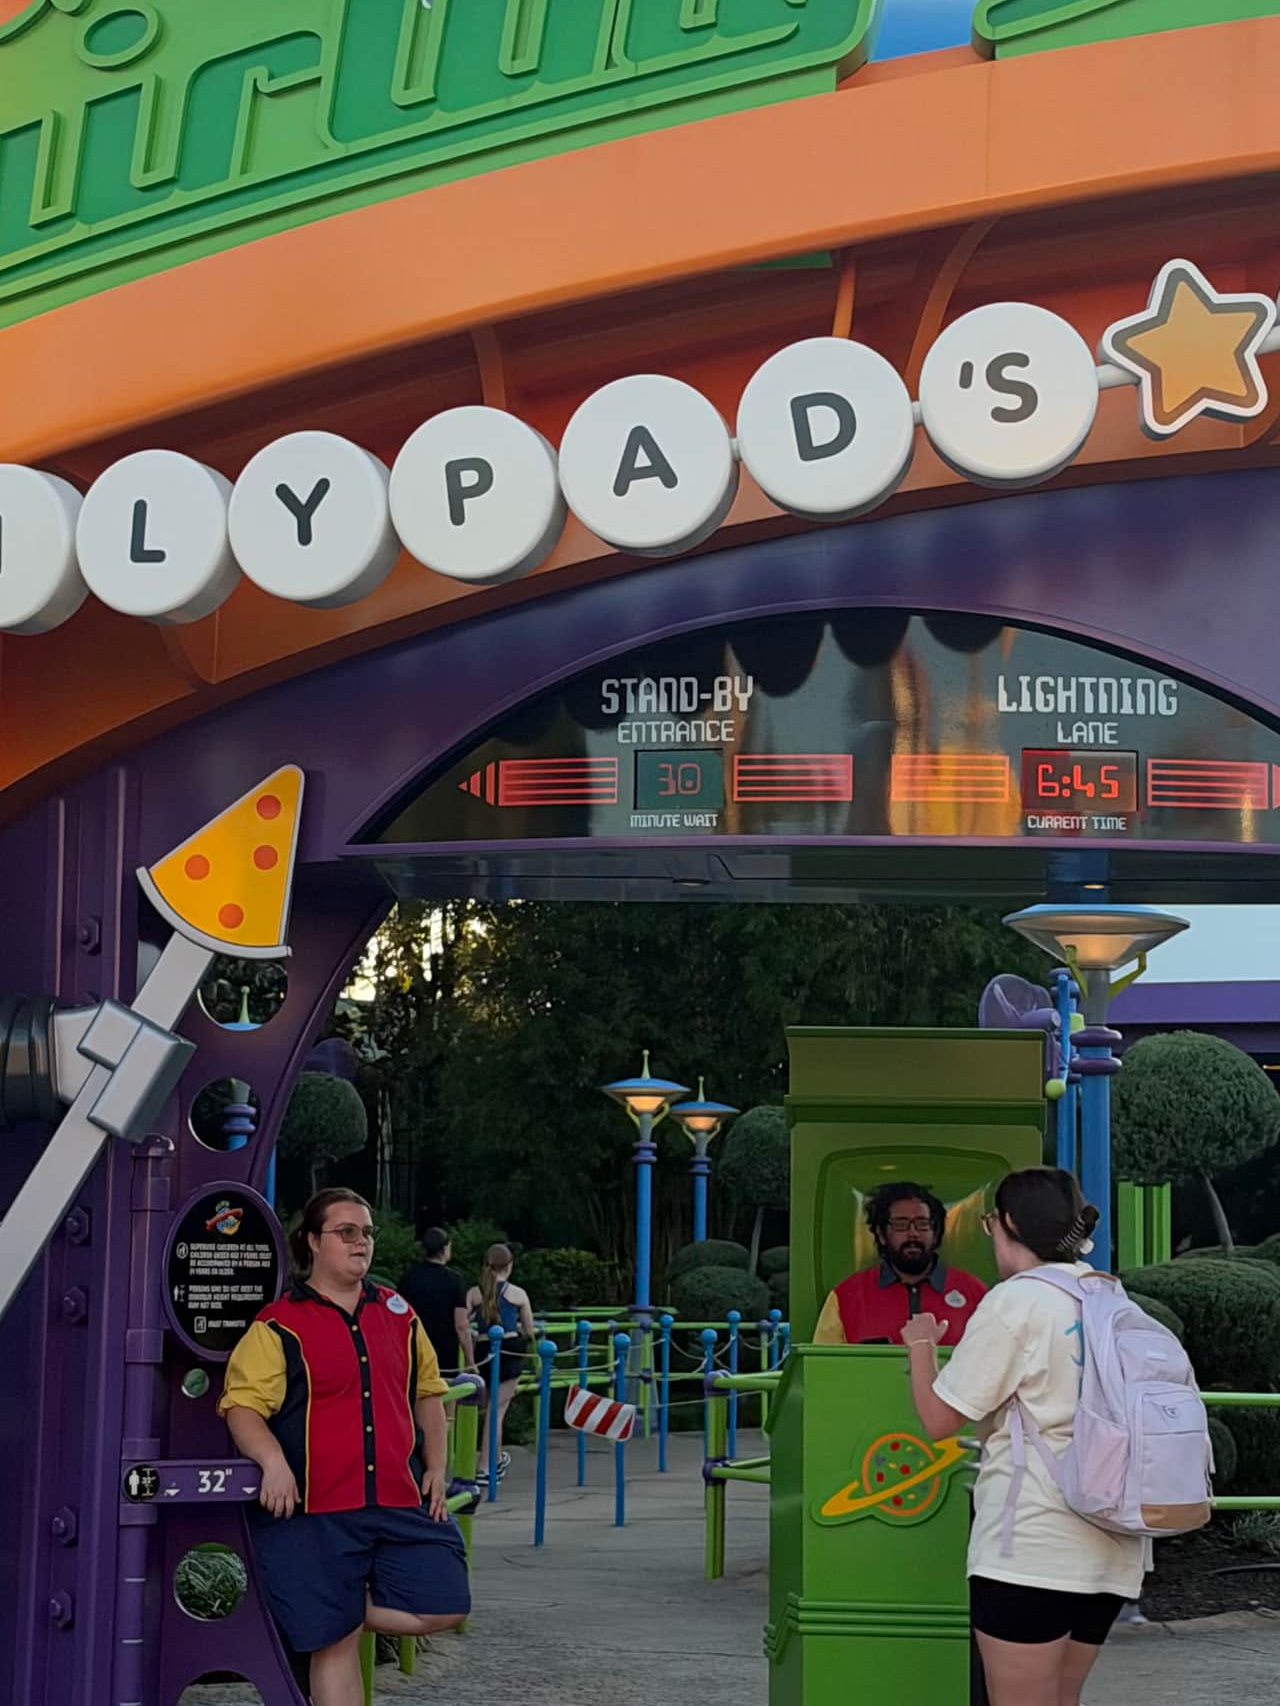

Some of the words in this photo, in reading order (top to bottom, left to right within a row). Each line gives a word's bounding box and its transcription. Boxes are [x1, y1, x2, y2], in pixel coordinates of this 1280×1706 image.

[601, 676, 753, 714] STAND-BY
[998, 675, 1178, 715] LIGHTNING
[617, 720, 735, 743] ENTRANCE
[1057, 721, 1118, 744] LANE
[657, 763, 702, 796] 30
[1037, 764, 1119, 797] 6:45
[630, 814, 680, 827] MINUTE
[683, 814, 718, 827] WAIT
[1027, 816, 1087, 830] CURRENT
[1091, 817, 1127, 830] TIME
[198, 1469, 232, 1493] 32"
